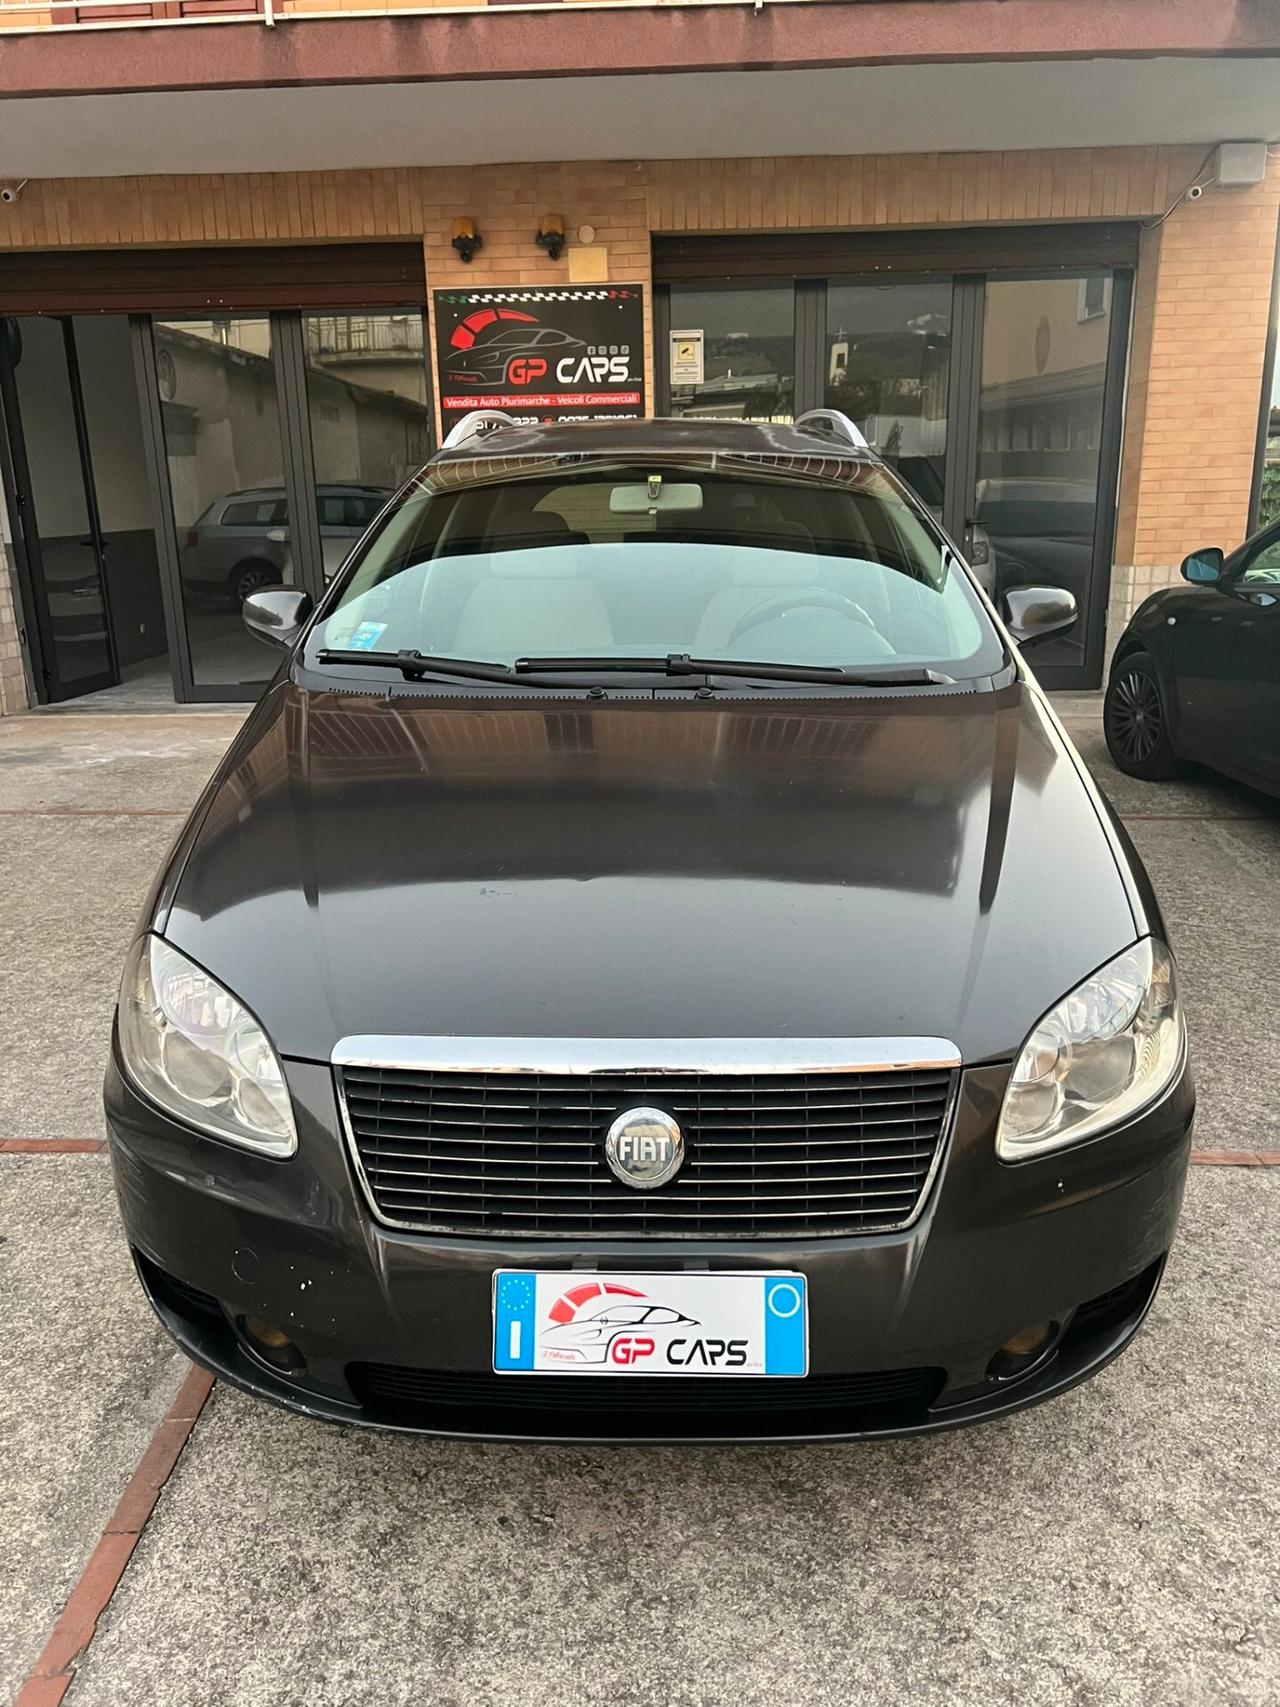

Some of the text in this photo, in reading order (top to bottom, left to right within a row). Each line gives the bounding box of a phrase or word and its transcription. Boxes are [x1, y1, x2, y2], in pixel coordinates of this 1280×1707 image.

[508, 358, 548, 385] GP
[446, 397, 478, 408] Vendita
[480, 396, 499, 407] Auto
[501, 395, 550, 406] Plurimarche
[557, 394, 584, 405] Veicoli
[585, 393, 637, 404] Commerciali
[619, 1136, 670, 1162] FIAT
[611, 1338, 656, 1365] GP
